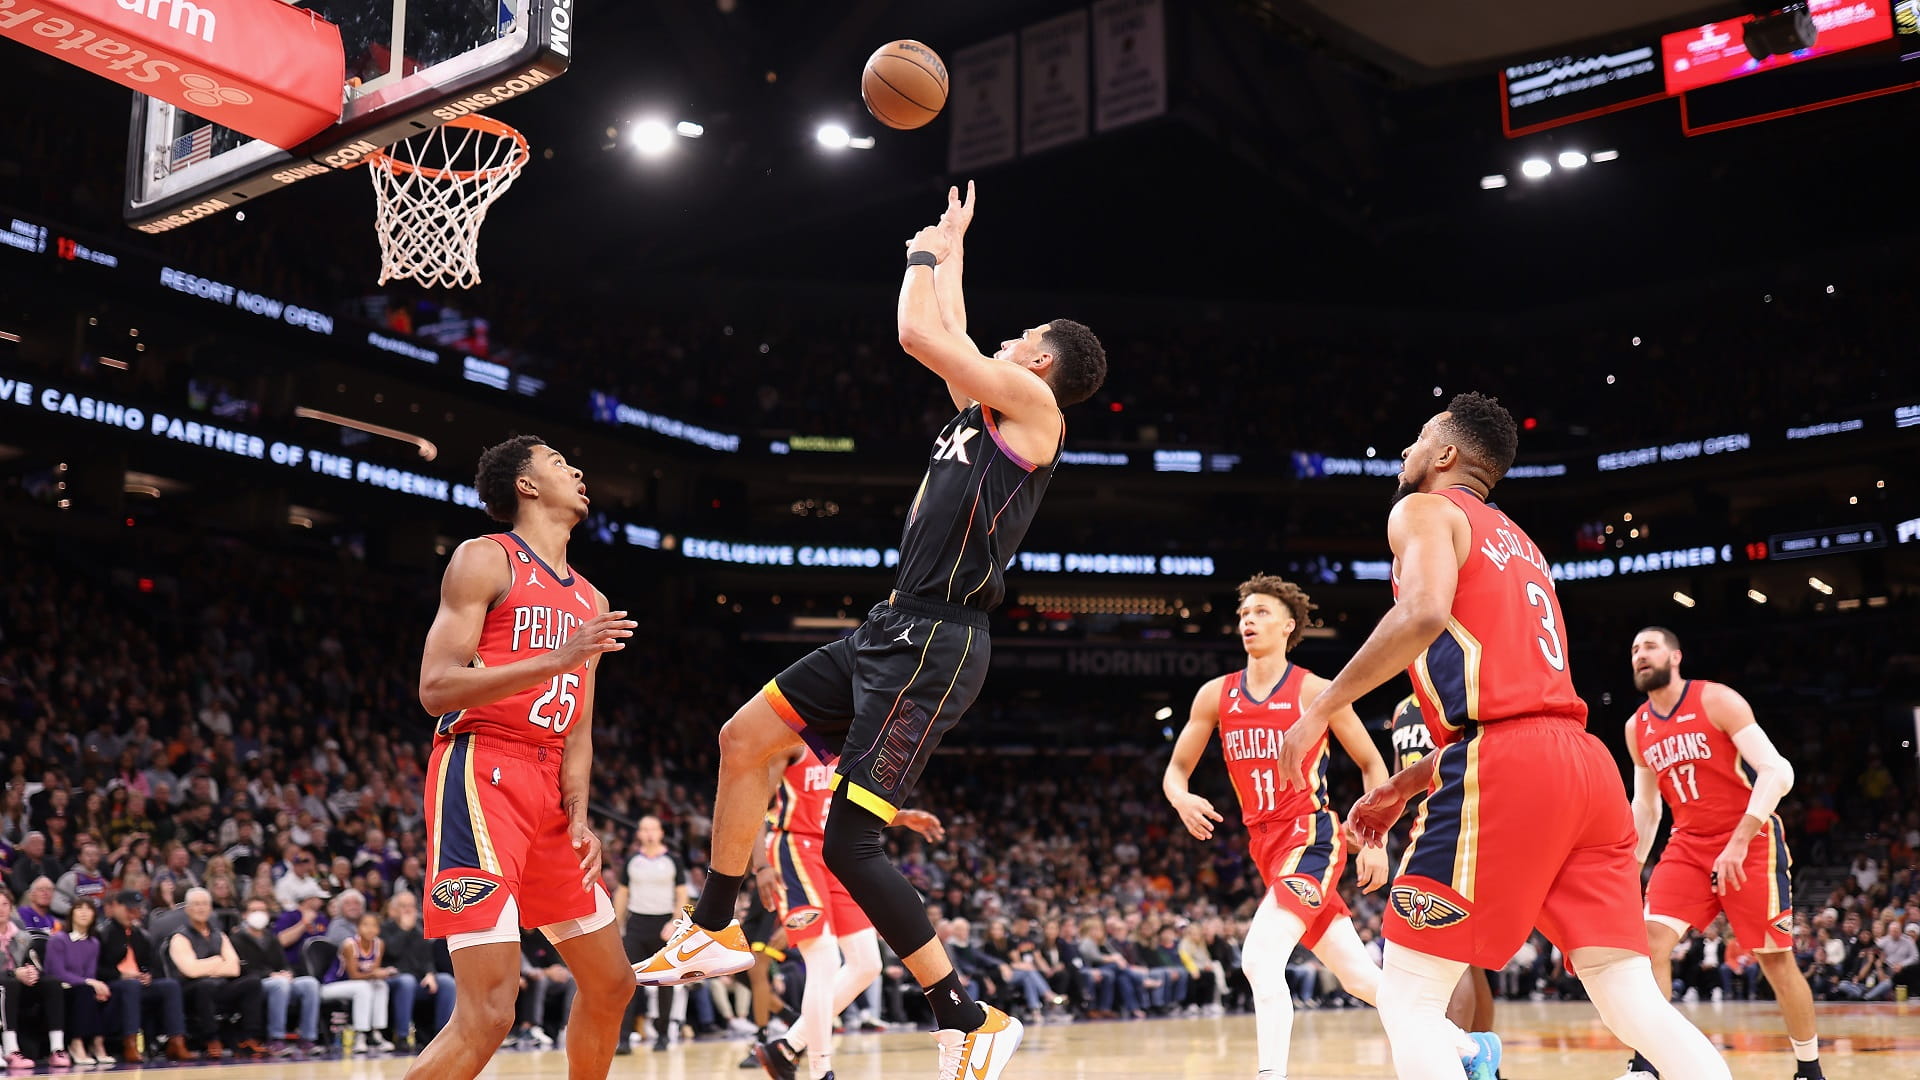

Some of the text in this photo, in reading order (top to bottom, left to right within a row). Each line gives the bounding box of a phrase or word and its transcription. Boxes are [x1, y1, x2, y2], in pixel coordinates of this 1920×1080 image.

[432, 68, 550, 121] SUNS.COM
[271, 139, 379, 184] SUNS.COM
[137, 197, 230, 235] SUNS.COM
[160, 266, 334, 336] RESORT NOW OPEN
[41, 388, 145, 431] CASINO
[151, 413, 265, 460] PARTNER
[269, 442, 304, 467] OF
[308, 450, 353, 480] THE
[356, 461, 449, 502] PHOENIX
[1597, 432, 1751, 472] RESORT NOW OPEN
[682, 536, 795, 566] EXCLUSIVE
[797, 546, 881, 568] CASINO
[1019, 552, 1216, 577] THE PHOENIX SUNS
[1551, 557, 1616, 581] ASINO
[1618, 546, 1717, 575] PARTNER
[1525, 581, 1565, 672] 3
[528, 672, 579, 734] 25
[870, 699, 927, 791] SUNS
[1392, 723, 1437, 750] PHX
[1642, 732, 1713, 773] PELICANS
[1250, 767, 1276, 812] 11
[1667, 762, 1700, 804] 17
